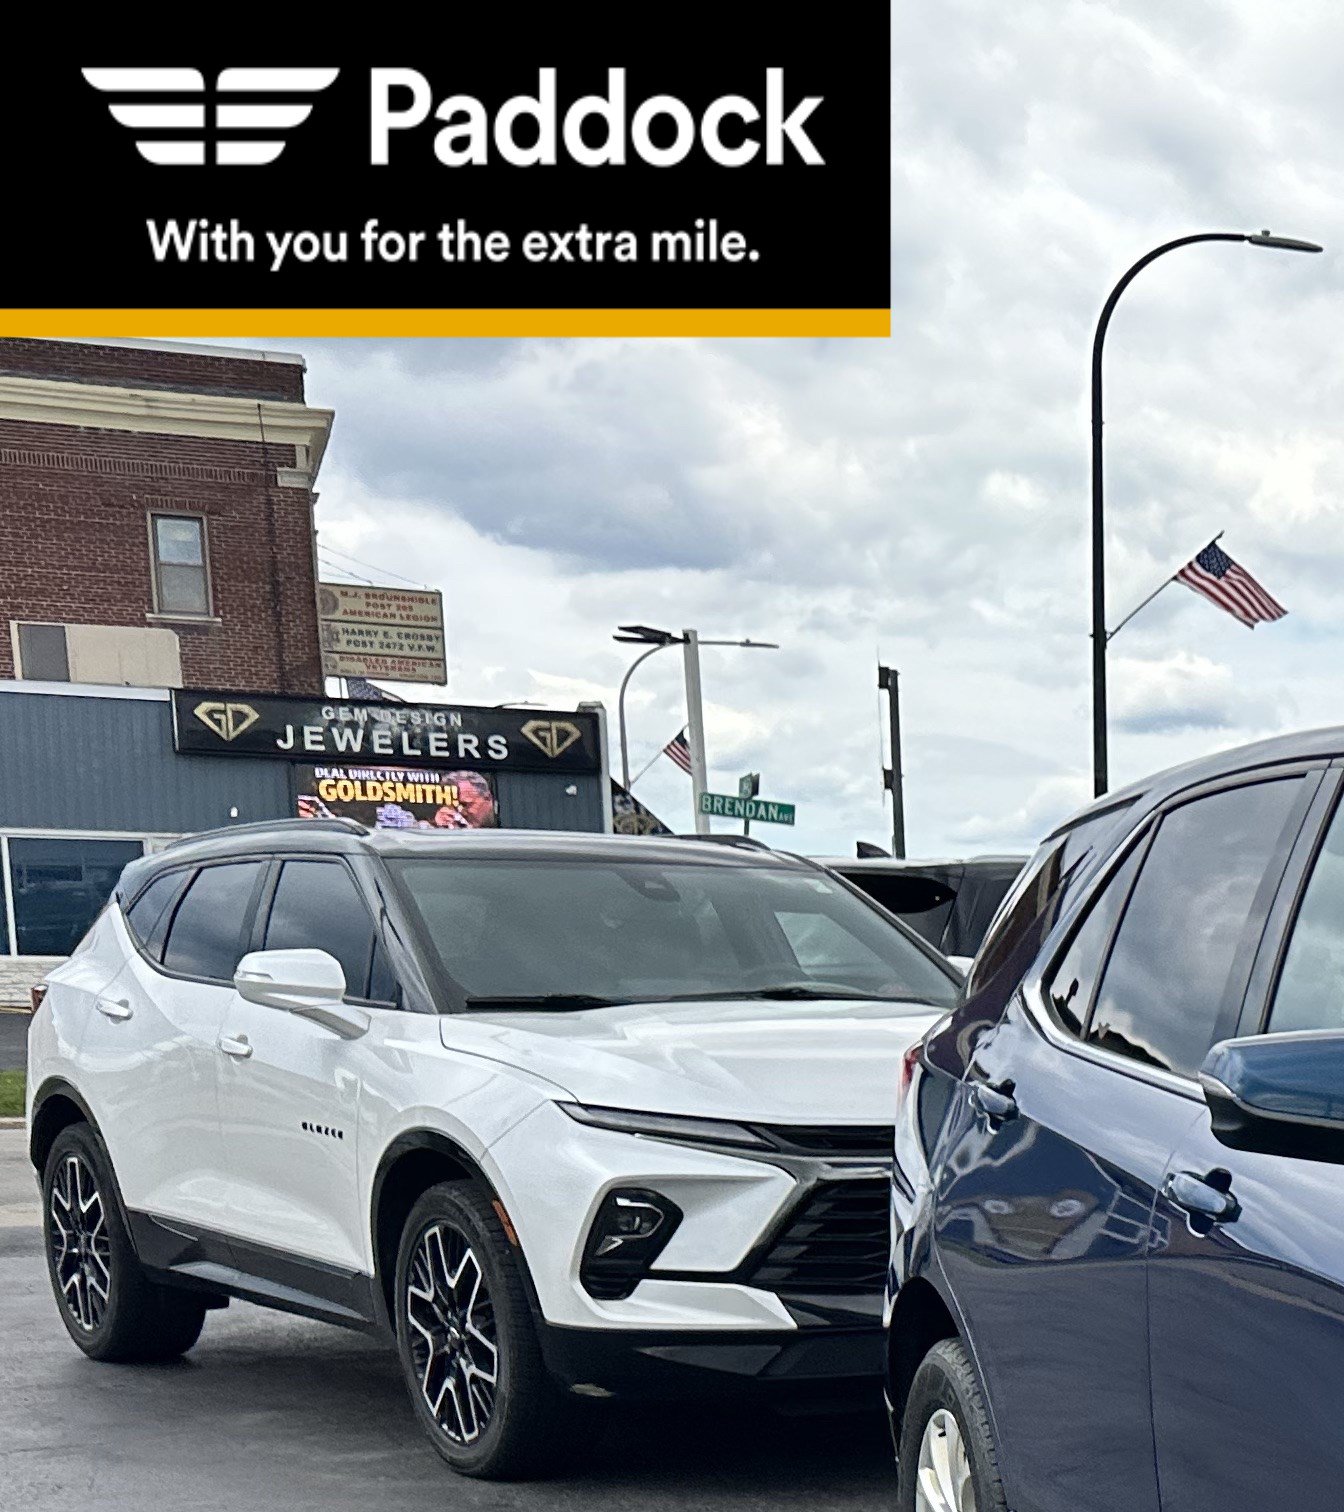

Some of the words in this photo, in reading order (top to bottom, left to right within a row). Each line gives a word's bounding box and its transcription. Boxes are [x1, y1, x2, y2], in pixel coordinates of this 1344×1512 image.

[342, 608, 397, 619] AMERICAN
[399, 614, 438, 623] LEGION
[365, 601, 392, 611] POST
[341, 627, 379, 638] HARRY
[397, 632, 440, 642] CROSBY
[346, 640, 375, 649] POST
[321, 706, 368, 722] GEM
[378, 709, 462, 727] DESIGN
[276, 724, 509, 760] JEWELERS
[318, 779, 459, 806] GOLDSMITH!
[702, 795, 779, 820] BRENDAN
[302, 1121, 344, 1140] BLAZER
